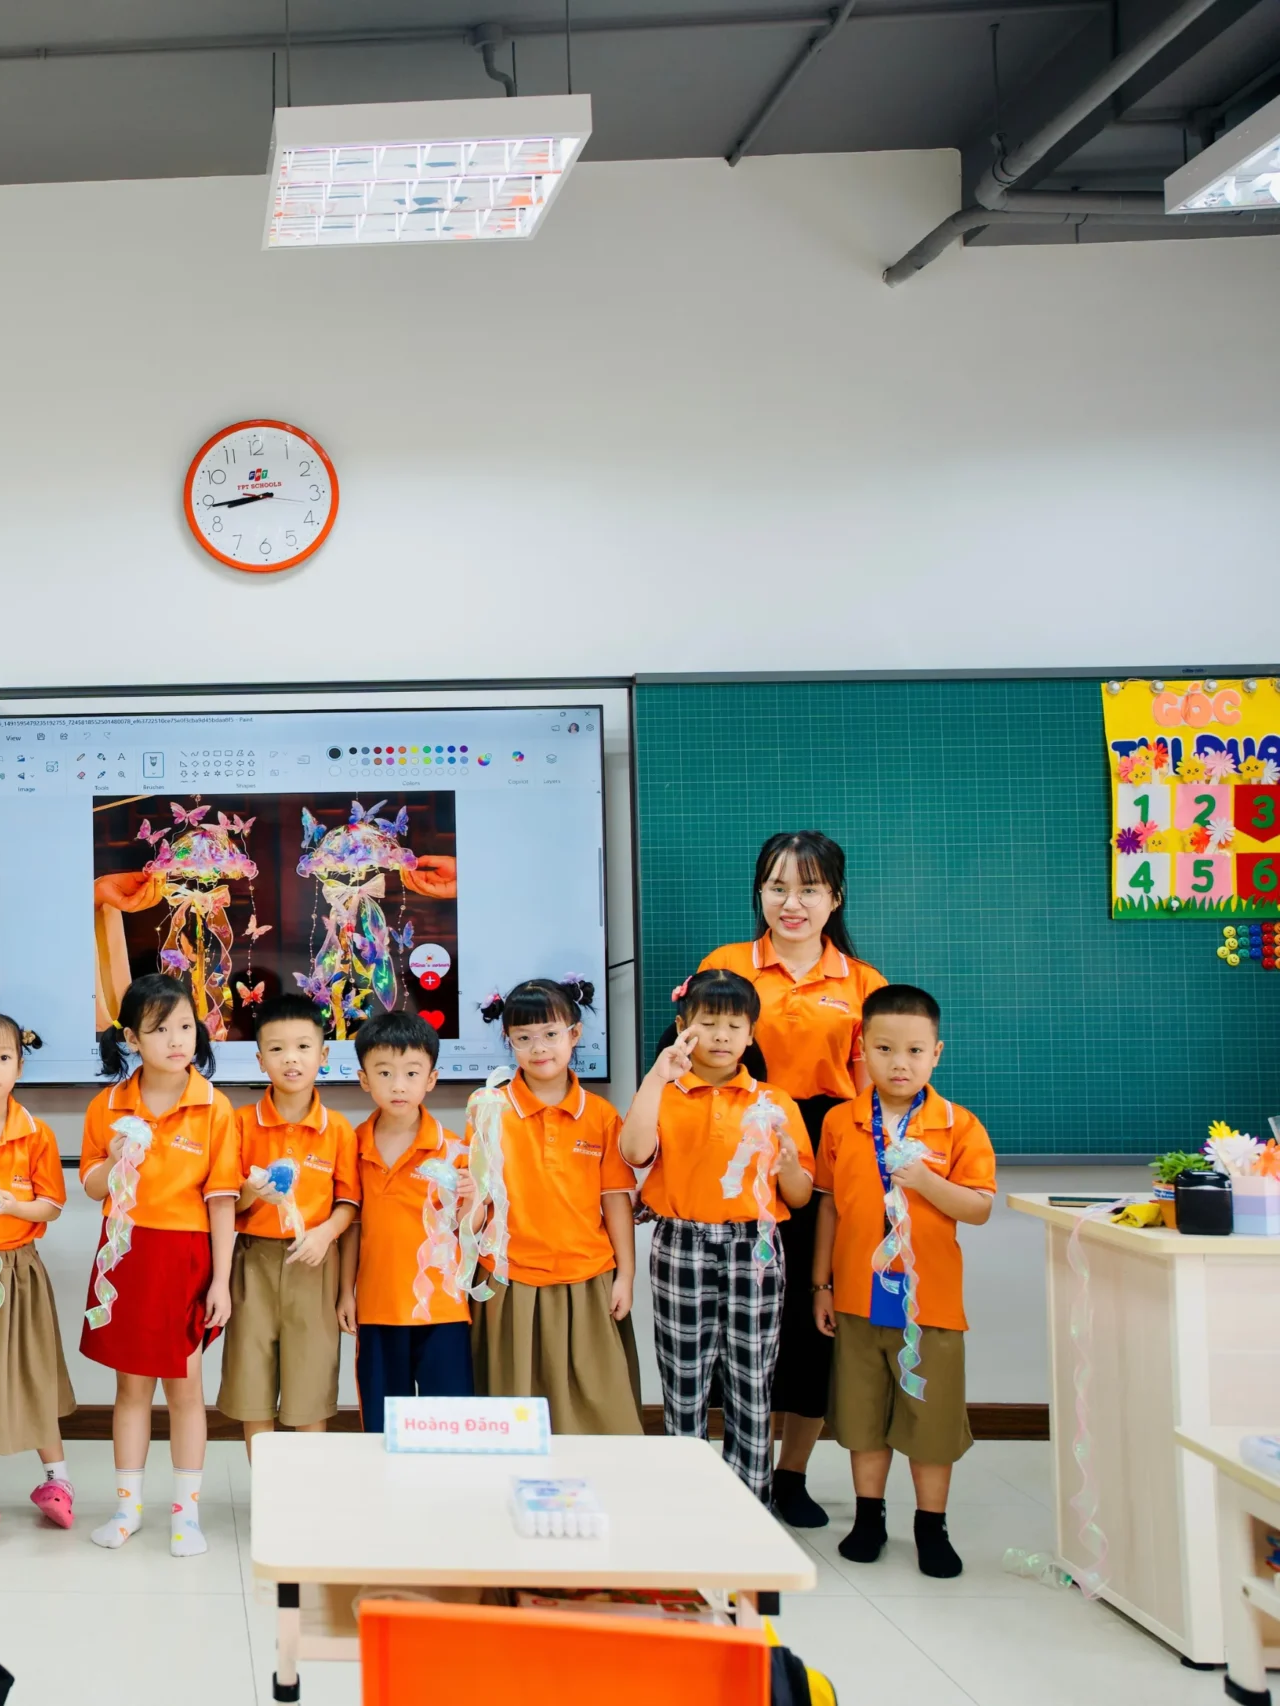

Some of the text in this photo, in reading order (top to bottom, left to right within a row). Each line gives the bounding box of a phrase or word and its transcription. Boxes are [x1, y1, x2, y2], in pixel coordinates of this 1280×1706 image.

[248, 440, 264, 456] 12
[284, 444, 289, 460] 1
[224, 449, 236, 465] 11
[207, 469, 227, 485] 10
[299, 461, 311, 477] 2
[250, 482, 282, 490] SCHOOLS
[309, 484, 321, 501] 3
[202, 494, 215, 511] 9
[212, 516, 223, 533] 8
[303, 510, 315, 526] 4
[232, 534, 242, 550] 7
[259, 538, 272, 555] 6
[285, 530, 297, 547] 5
[1152, 681, 1242, 728] GÓC
[1134, 794, 1150, 822] 1
[1193, 794, 1216, 827] 2
[1251, 795, 1275, 829] 3
[1129, 860, 1154, 894] 4
[1191, 859, 1214, 893] 5
[1252, 858, 1278, 892] 6
[404, 1417, 510, 1434] Hoàng Đăng
